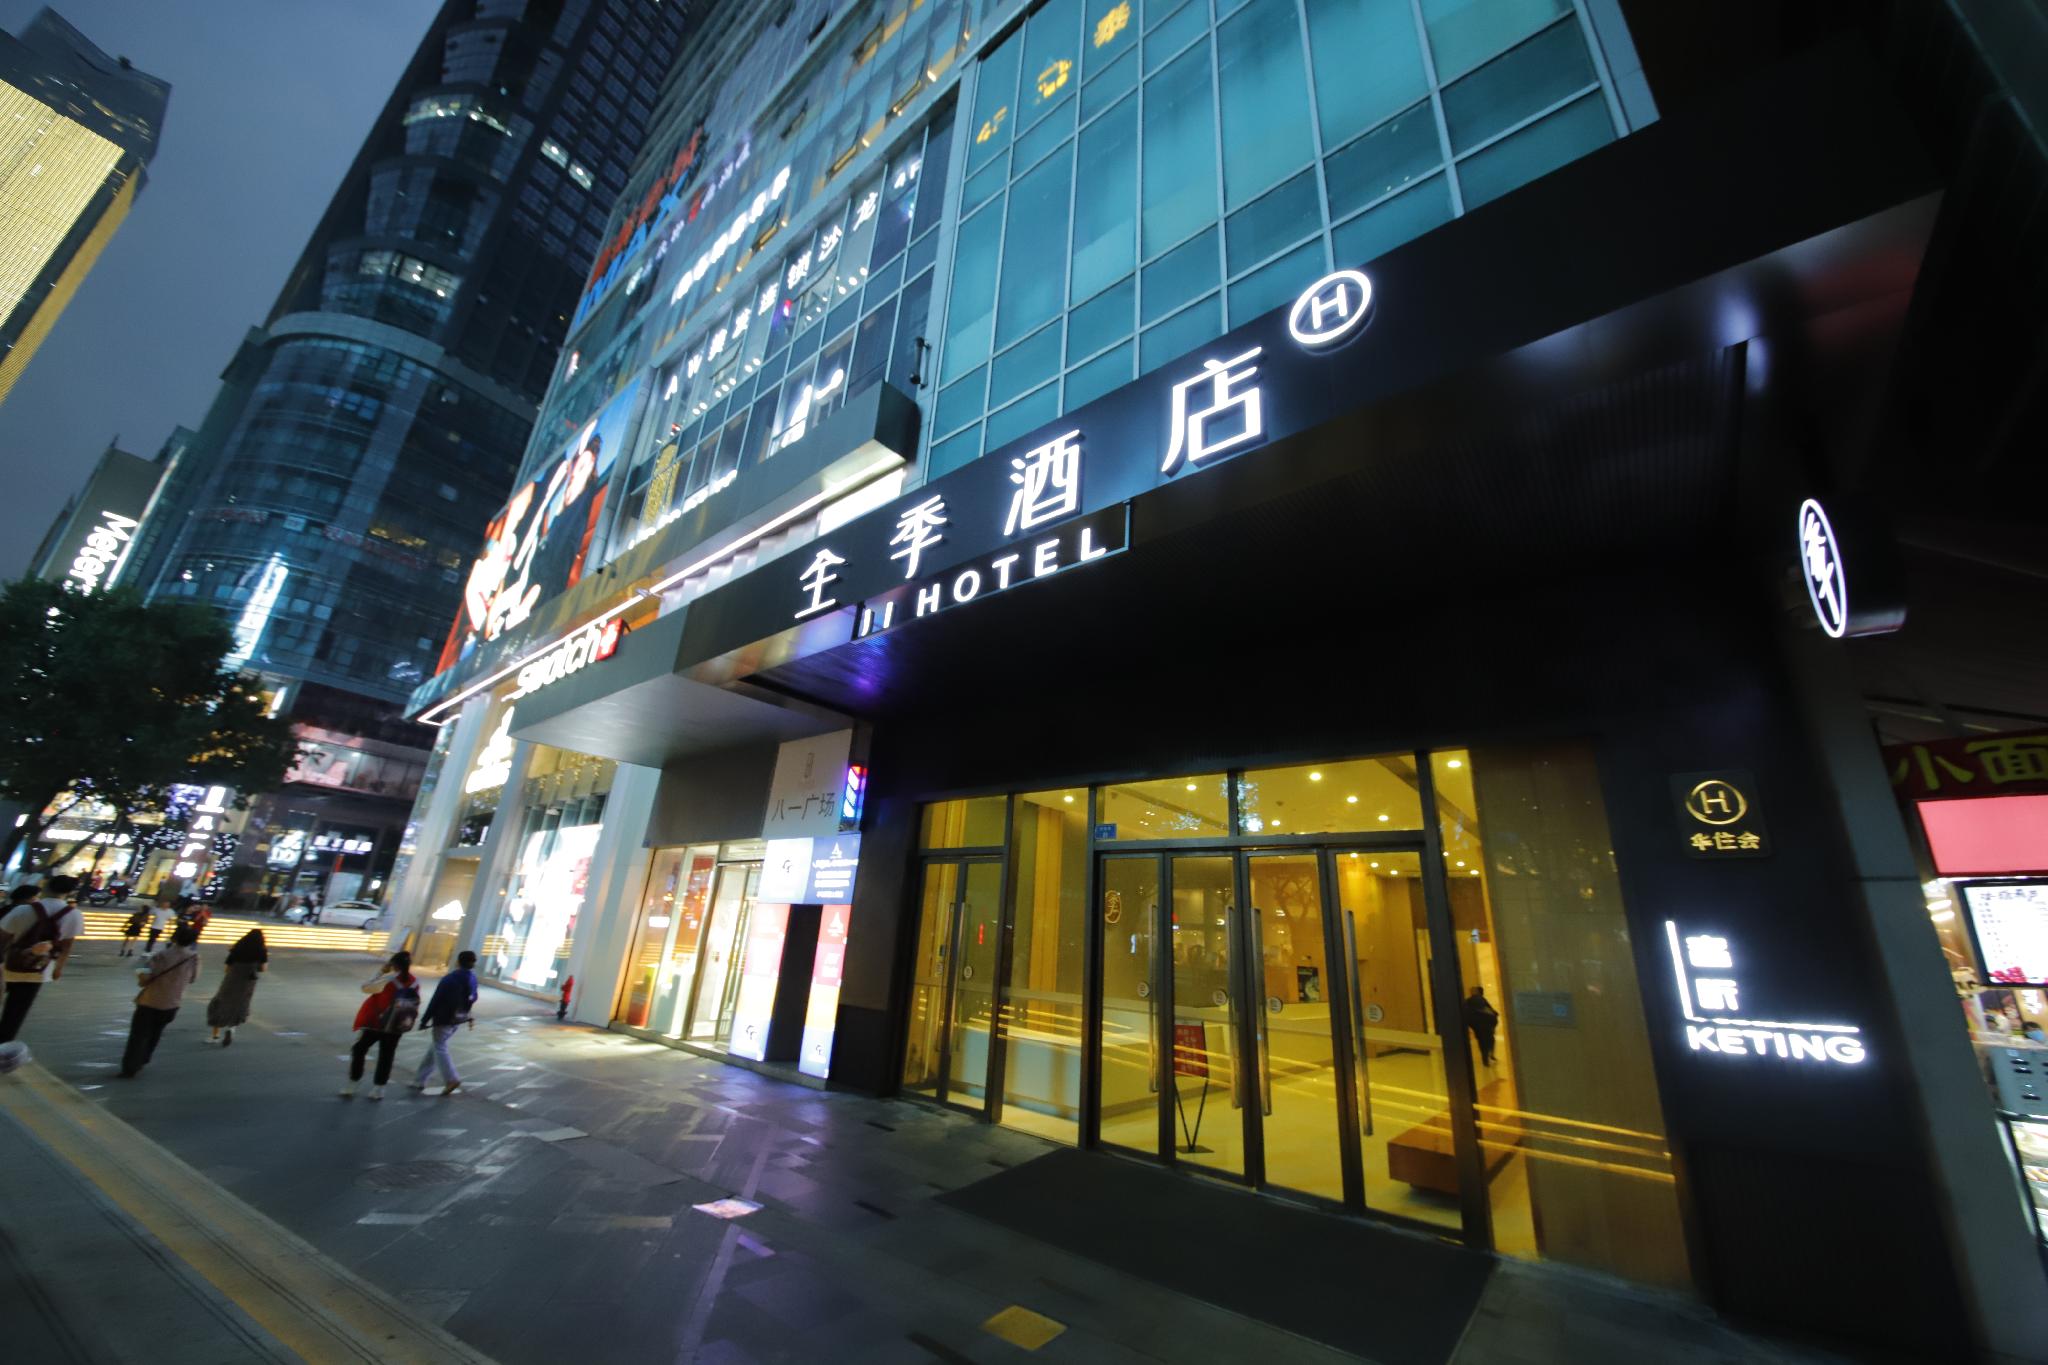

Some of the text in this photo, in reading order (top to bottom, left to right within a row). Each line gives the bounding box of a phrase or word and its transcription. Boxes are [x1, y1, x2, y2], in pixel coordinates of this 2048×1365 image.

[794, 346, 1264, 619] 全季酒店
[917, 527, 1107, 618] HOTEL
[509, 622, 603, 702] swatch
[1891, 734, 2048, 791] 小面
[771, 792, 836, 822] 八一广场
[1690, 831, 1761, 852] 华住会
[1685, 1025, 1866, 1065] KETING
